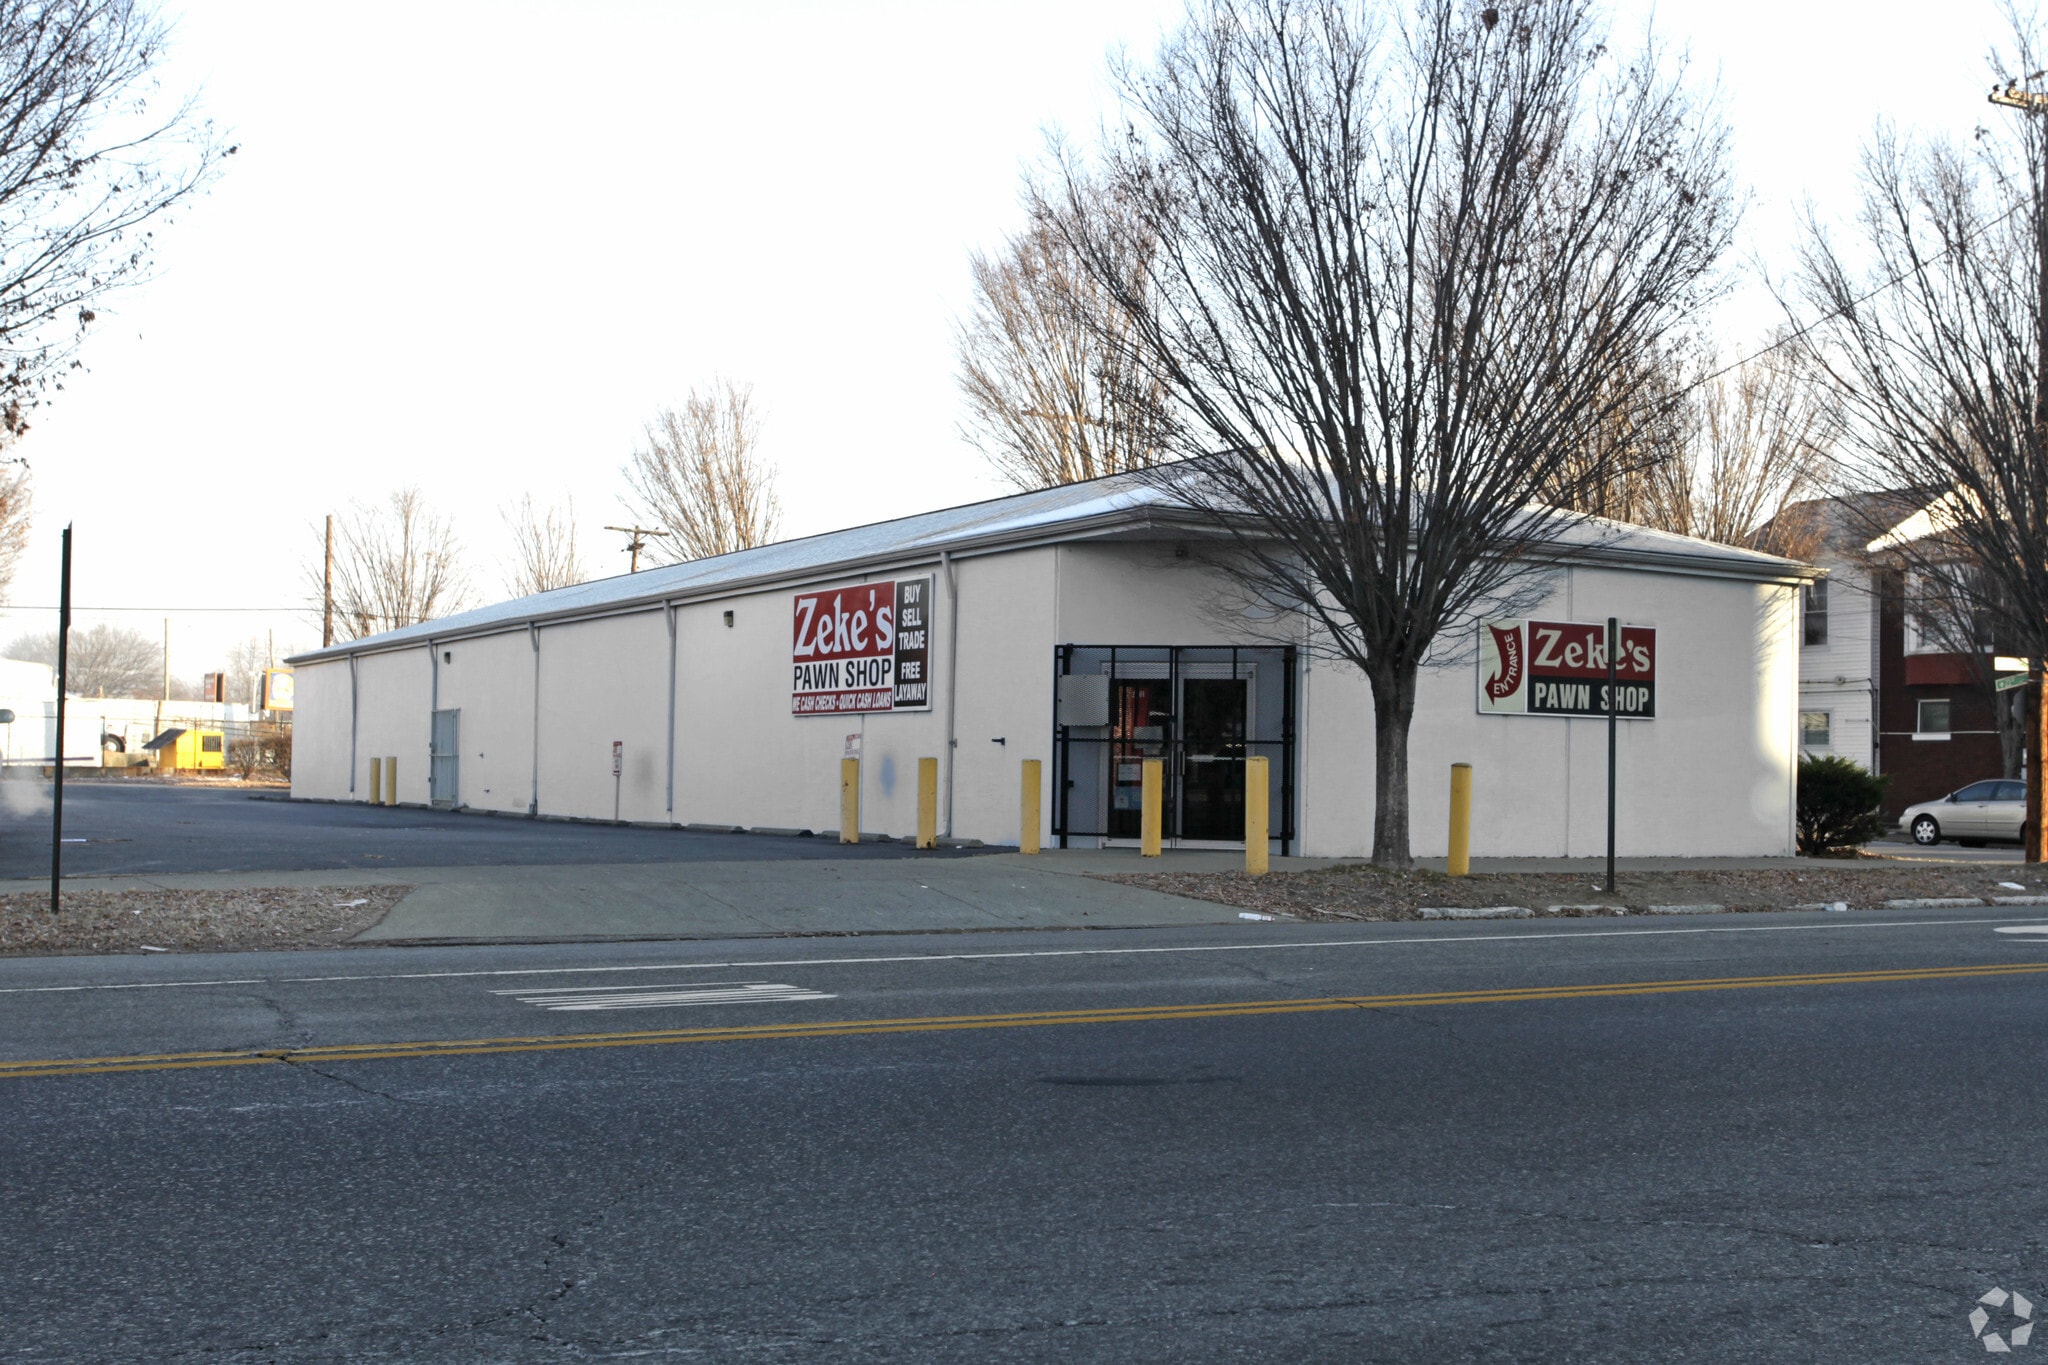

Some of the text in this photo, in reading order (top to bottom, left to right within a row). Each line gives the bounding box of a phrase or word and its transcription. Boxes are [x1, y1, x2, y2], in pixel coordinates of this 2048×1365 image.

[904, 584, 921, 604] BUY
[794, 589, 893, 656] Zeke's
[902, 608, 921, 627] SELL
[898, 630, 925, 650] TRADE
[901, 661, 920, 679] FREE
[1493, 632, 1518, 695] ENTRANCE
[794, 658, 892, 691] PAWN SHOP
[801, 696, 814, 711] CASH
[857, 692, 873, 709] CASH
[894, 683, 927, 701] LAYAWAY
[1534, 682, 1649, 712] PAWN SHOP
